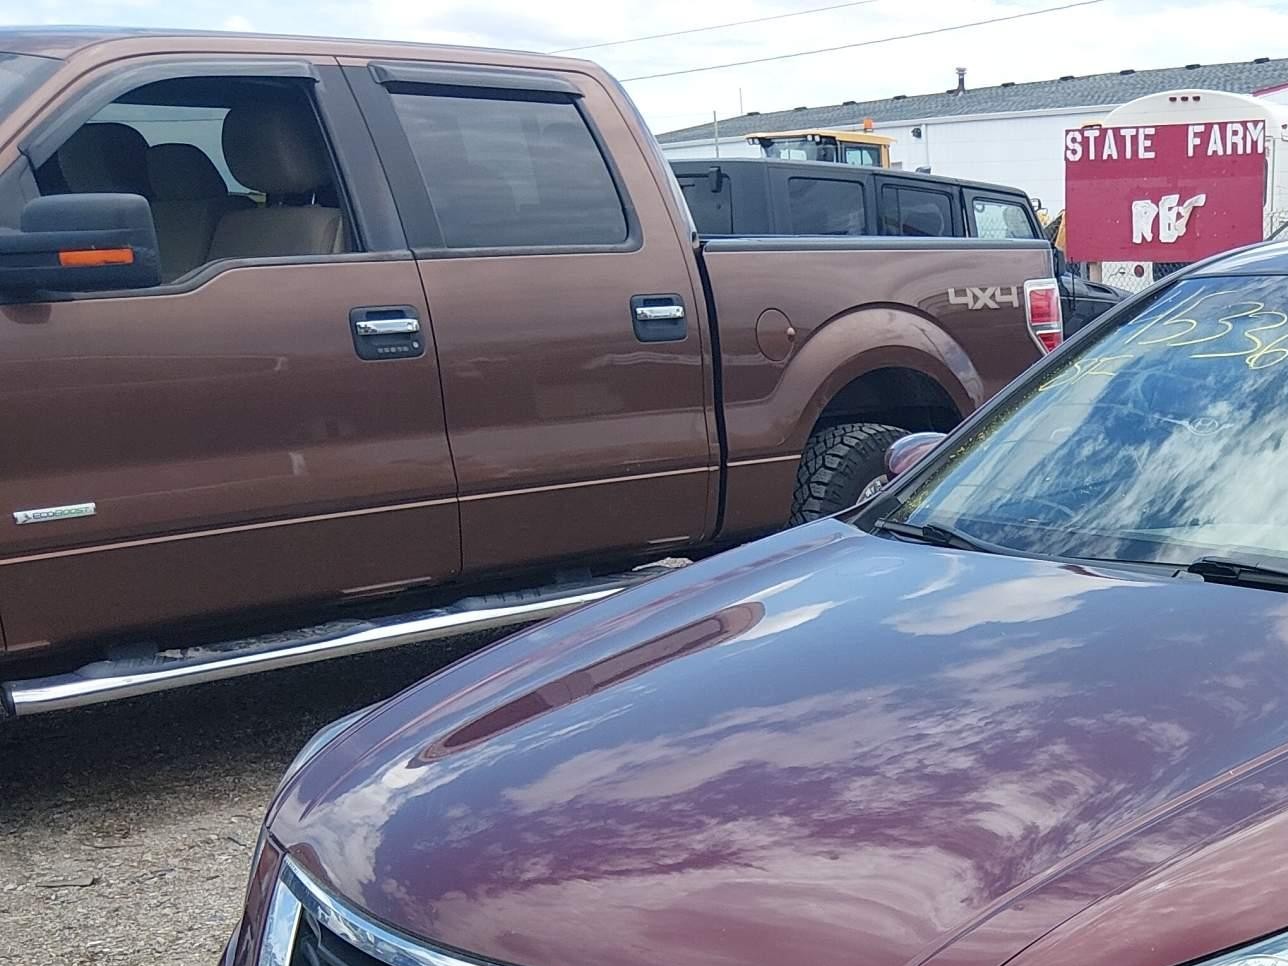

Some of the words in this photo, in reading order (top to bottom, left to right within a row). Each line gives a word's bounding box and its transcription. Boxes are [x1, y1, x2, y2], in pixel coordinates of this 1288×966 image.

[1065, 128, 1156, 161] STATE
[1187, 121, 1265, 157] FARM
[948, 285, 1020, 310] 4X4
